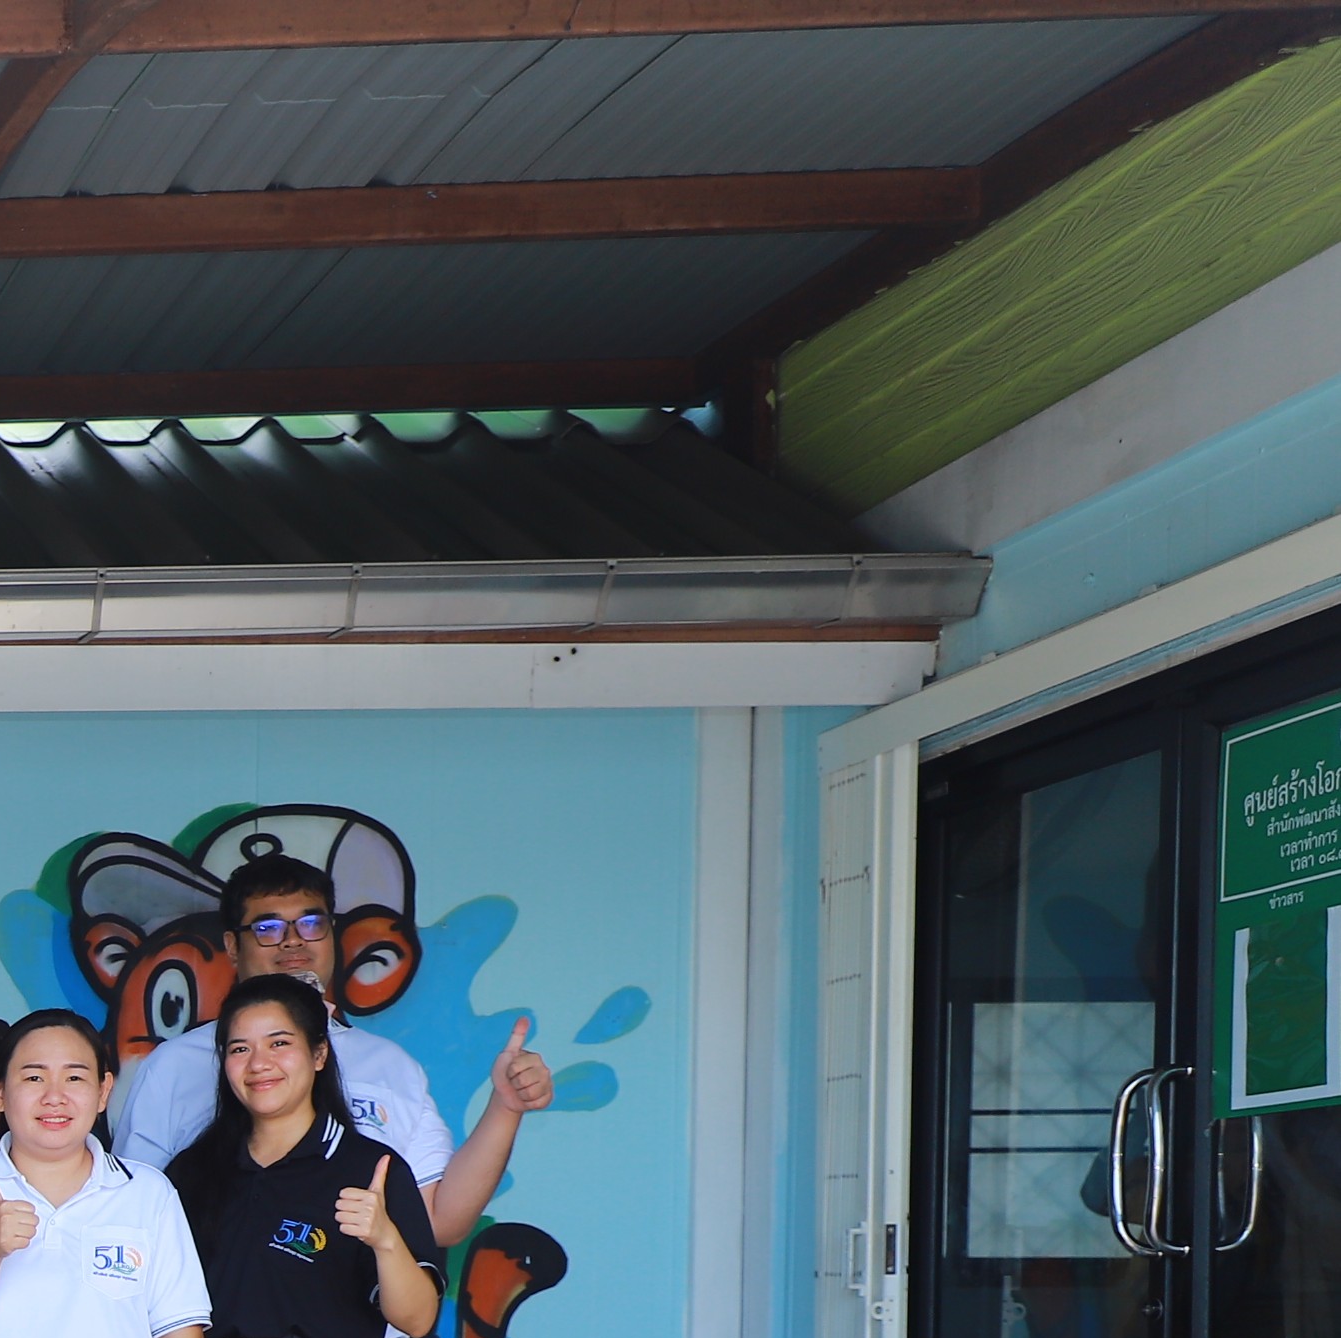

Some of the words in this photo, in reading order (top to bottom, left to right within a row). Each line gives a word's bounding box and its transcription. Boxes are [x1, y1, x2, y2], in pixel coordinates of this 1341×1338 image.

[1280, 829, 1338, 857] เวลาทำการ
[1290, 853, 1315, 872] เวลา
[1269, 890, 1304, 909] ข่าวสาร
[351, 1098, 379, 1119] 51
[273, 1218, 312, 1245] 51
[93, 1245, 125, 1270] 51
